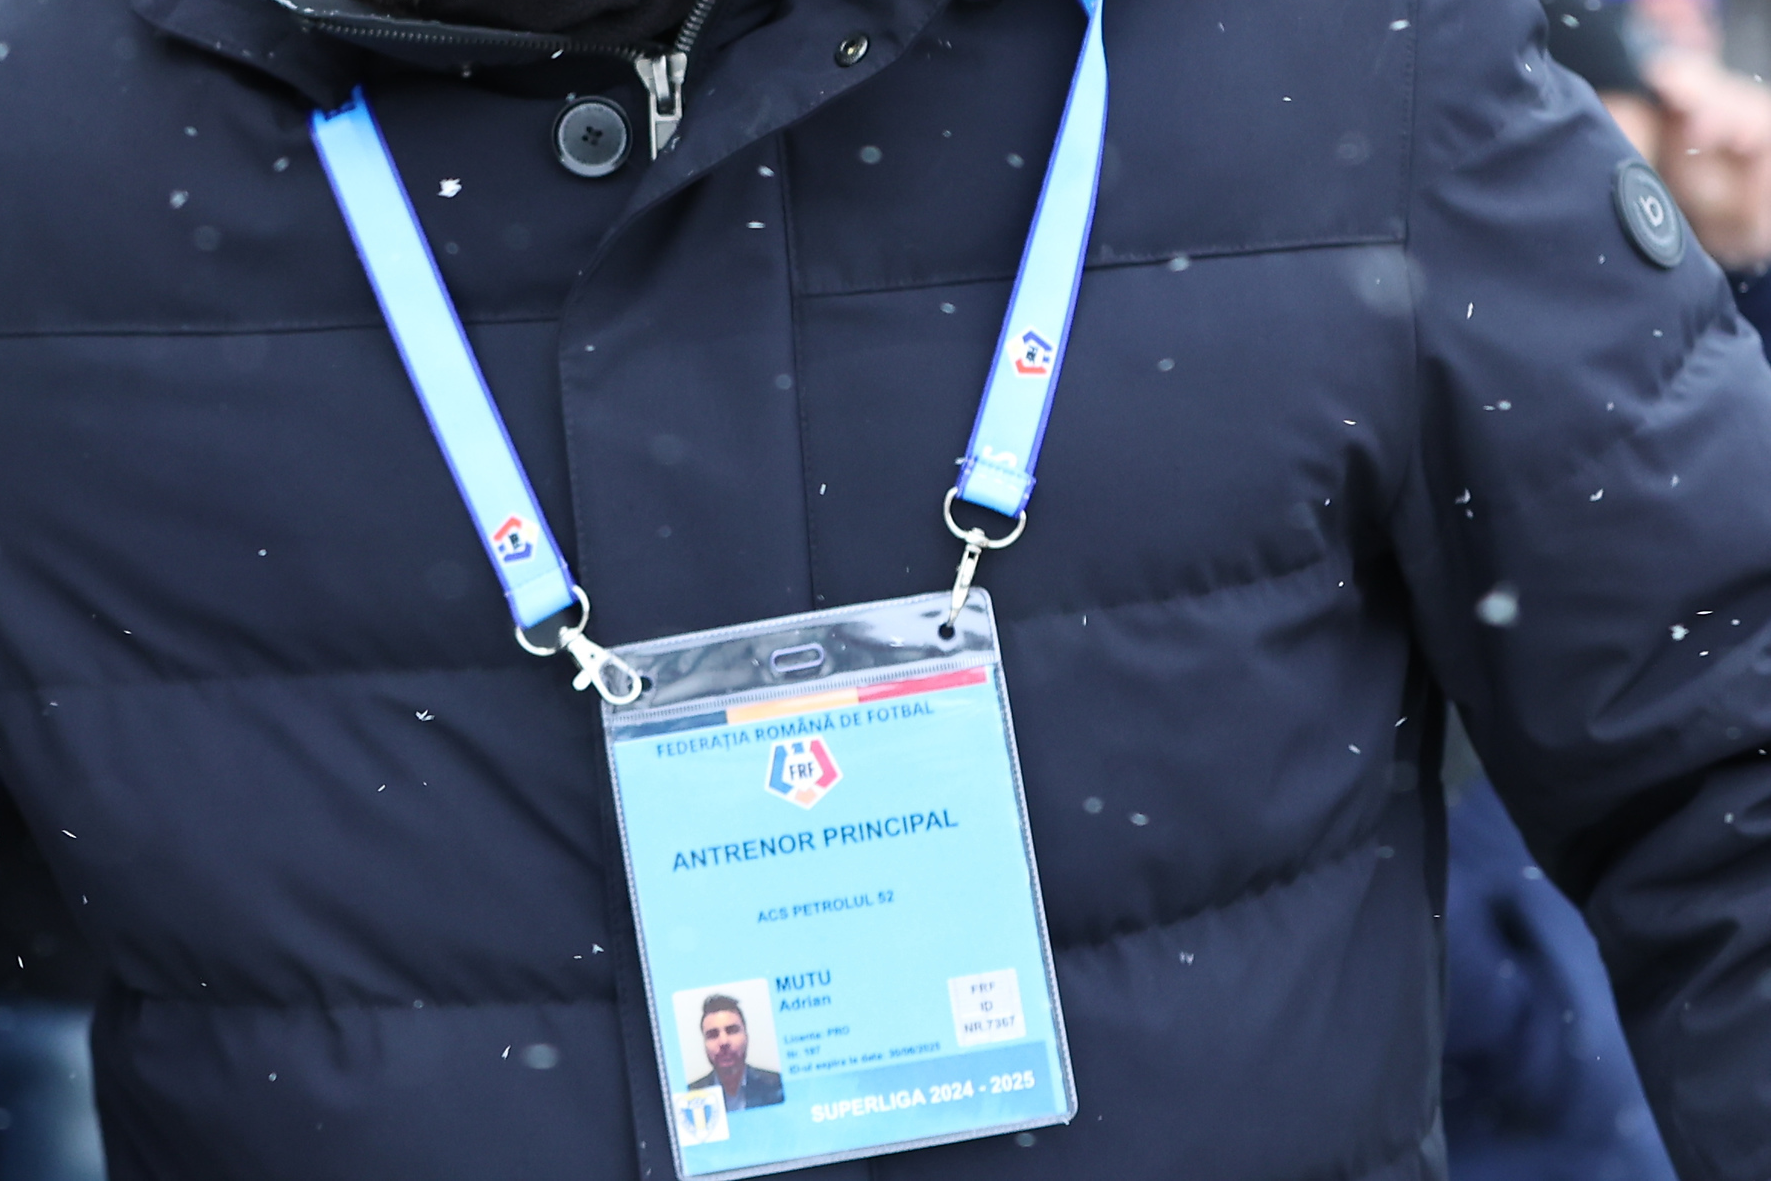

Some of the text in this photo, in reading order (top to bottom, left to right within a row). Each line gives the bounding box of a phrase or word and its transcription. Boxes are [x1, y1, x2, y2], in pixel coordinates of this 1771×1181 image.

[755, 712, 835, 741] ROMÂNĂ
[840, 711, 862, 728] DE
[868, 701, 935, 723] FOTBAL
[789, 761, 814, 780] FRF
[672, 809, 959, 872] ANTRENOR PRINCIPAL
[757, 890, 894, 923] ACS PETROLUL 52
[775, 969, 831, 992] MUTU
[780, 995, 831, 1012] Adrian
[810, 1088, 926, 1122] SUPERLIGA
[930, 1080, 974, 1104] 2024
[989, 1070, 1035, 1094] 2025
